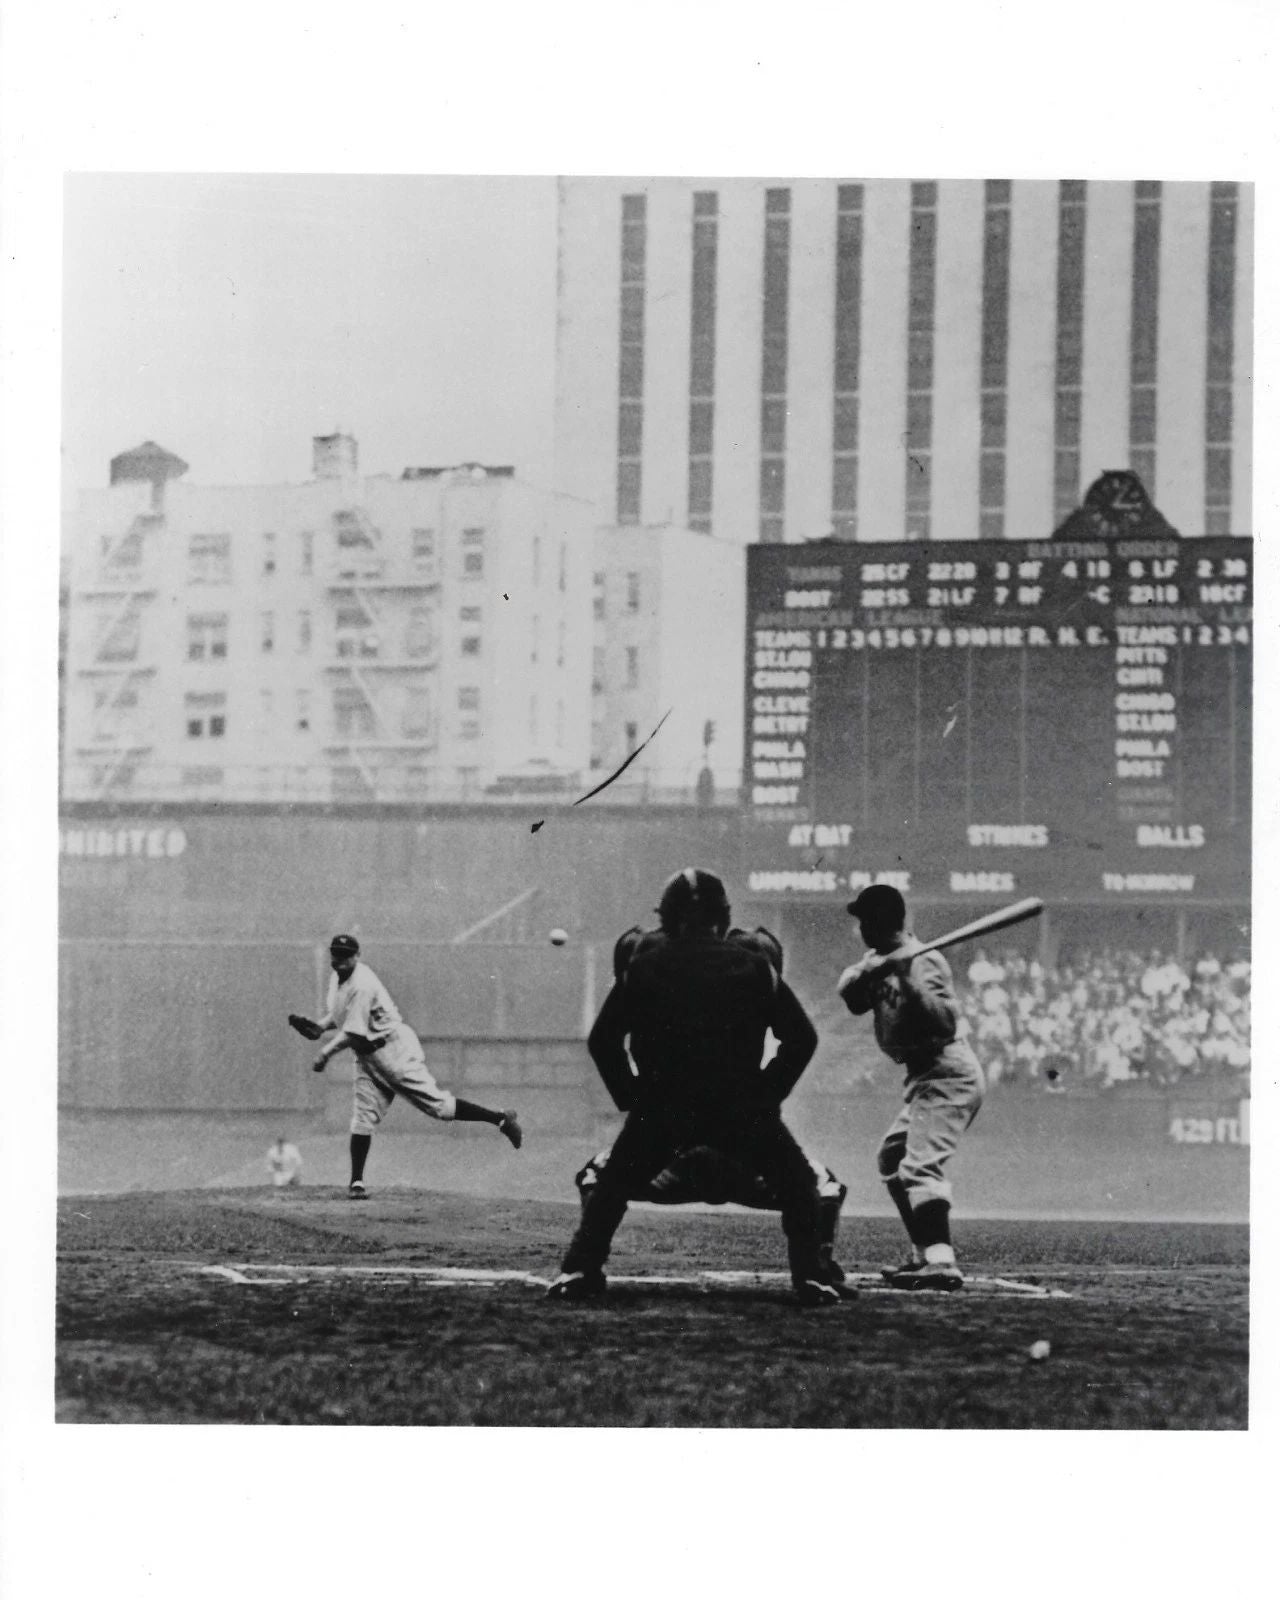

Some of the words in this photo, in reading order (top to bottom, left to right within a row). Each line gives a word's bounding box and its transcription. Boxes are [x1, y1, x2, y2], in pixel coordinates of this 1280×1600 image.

[754, 630, 811, 649] TEAMS
[1117, 626, 1177, 645] TEAMS
[58, 829, 187, 857] HIBITED
[1137, 824, 1205, 847] BALLS
